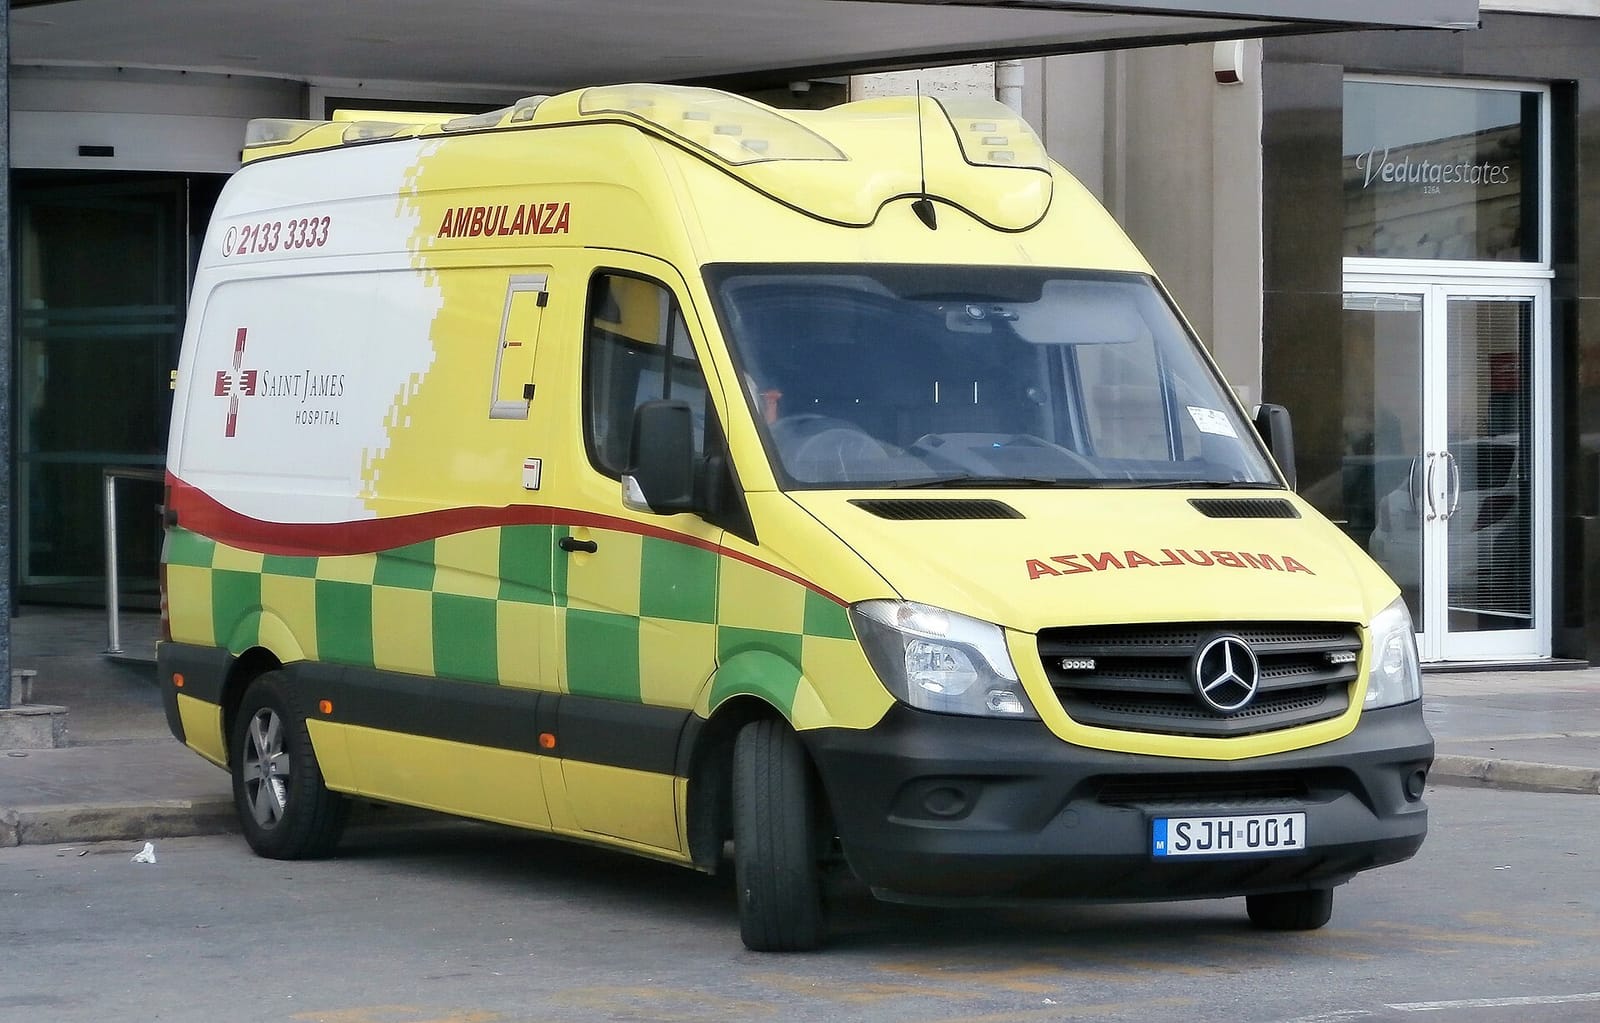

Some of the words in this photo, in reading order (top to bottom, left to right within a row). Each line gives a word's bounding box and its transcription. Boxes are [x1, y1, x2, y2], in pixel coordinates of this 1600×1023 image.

[1355, 145, 1510, 189] Vedutaestates
[236, 222, 282, 255] 2133
[283, 216, 331, 250] 3333
[437, 202, 571, 239] AMBULANZA
[261, 370, 301, 397] SAINT
[301, 370, 345, 403] JAMES
[295, 410, 340, 425] HOSPITAL
[1156, 841, 1164, 850] M
